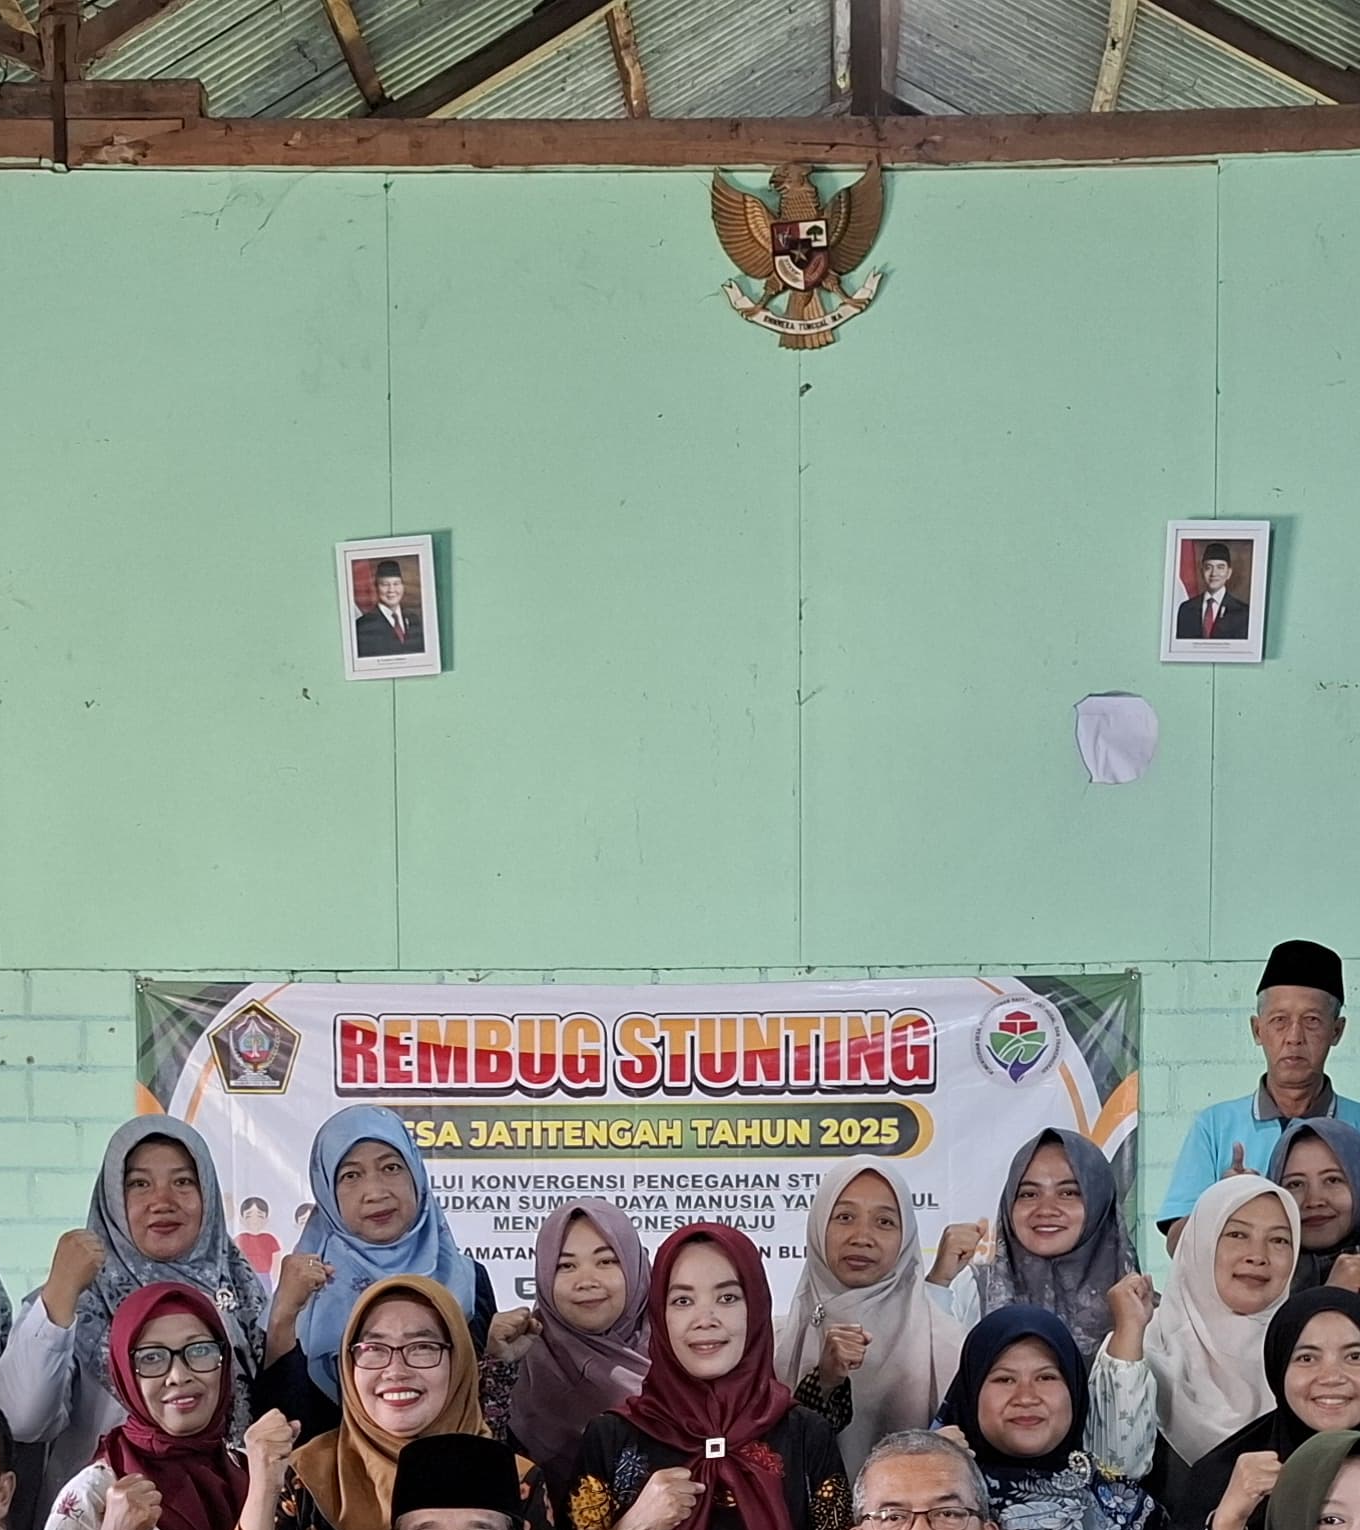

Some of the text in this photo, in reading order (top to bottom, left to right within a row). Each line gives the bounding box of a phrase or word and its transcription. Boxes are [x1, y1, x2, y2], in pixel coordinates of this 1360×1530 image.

[336, 1014, 605, 1091] REMBUG
[617, 1011, 935, 1089] STUNTING
[469, 1119, 682, 1147] JATITENGAH
[696, 1119, 811, 1146] TAHUN
[819, 1118, 899, 1146] 2025
[471, 1174, 625, 1190] KONVERGENSI
[633, 1174, 780, 1189] PENCEGAHAN
[615, 1195, 668, 1209] DAYA
[676, 1194, 774, 1209] MANUSIA
